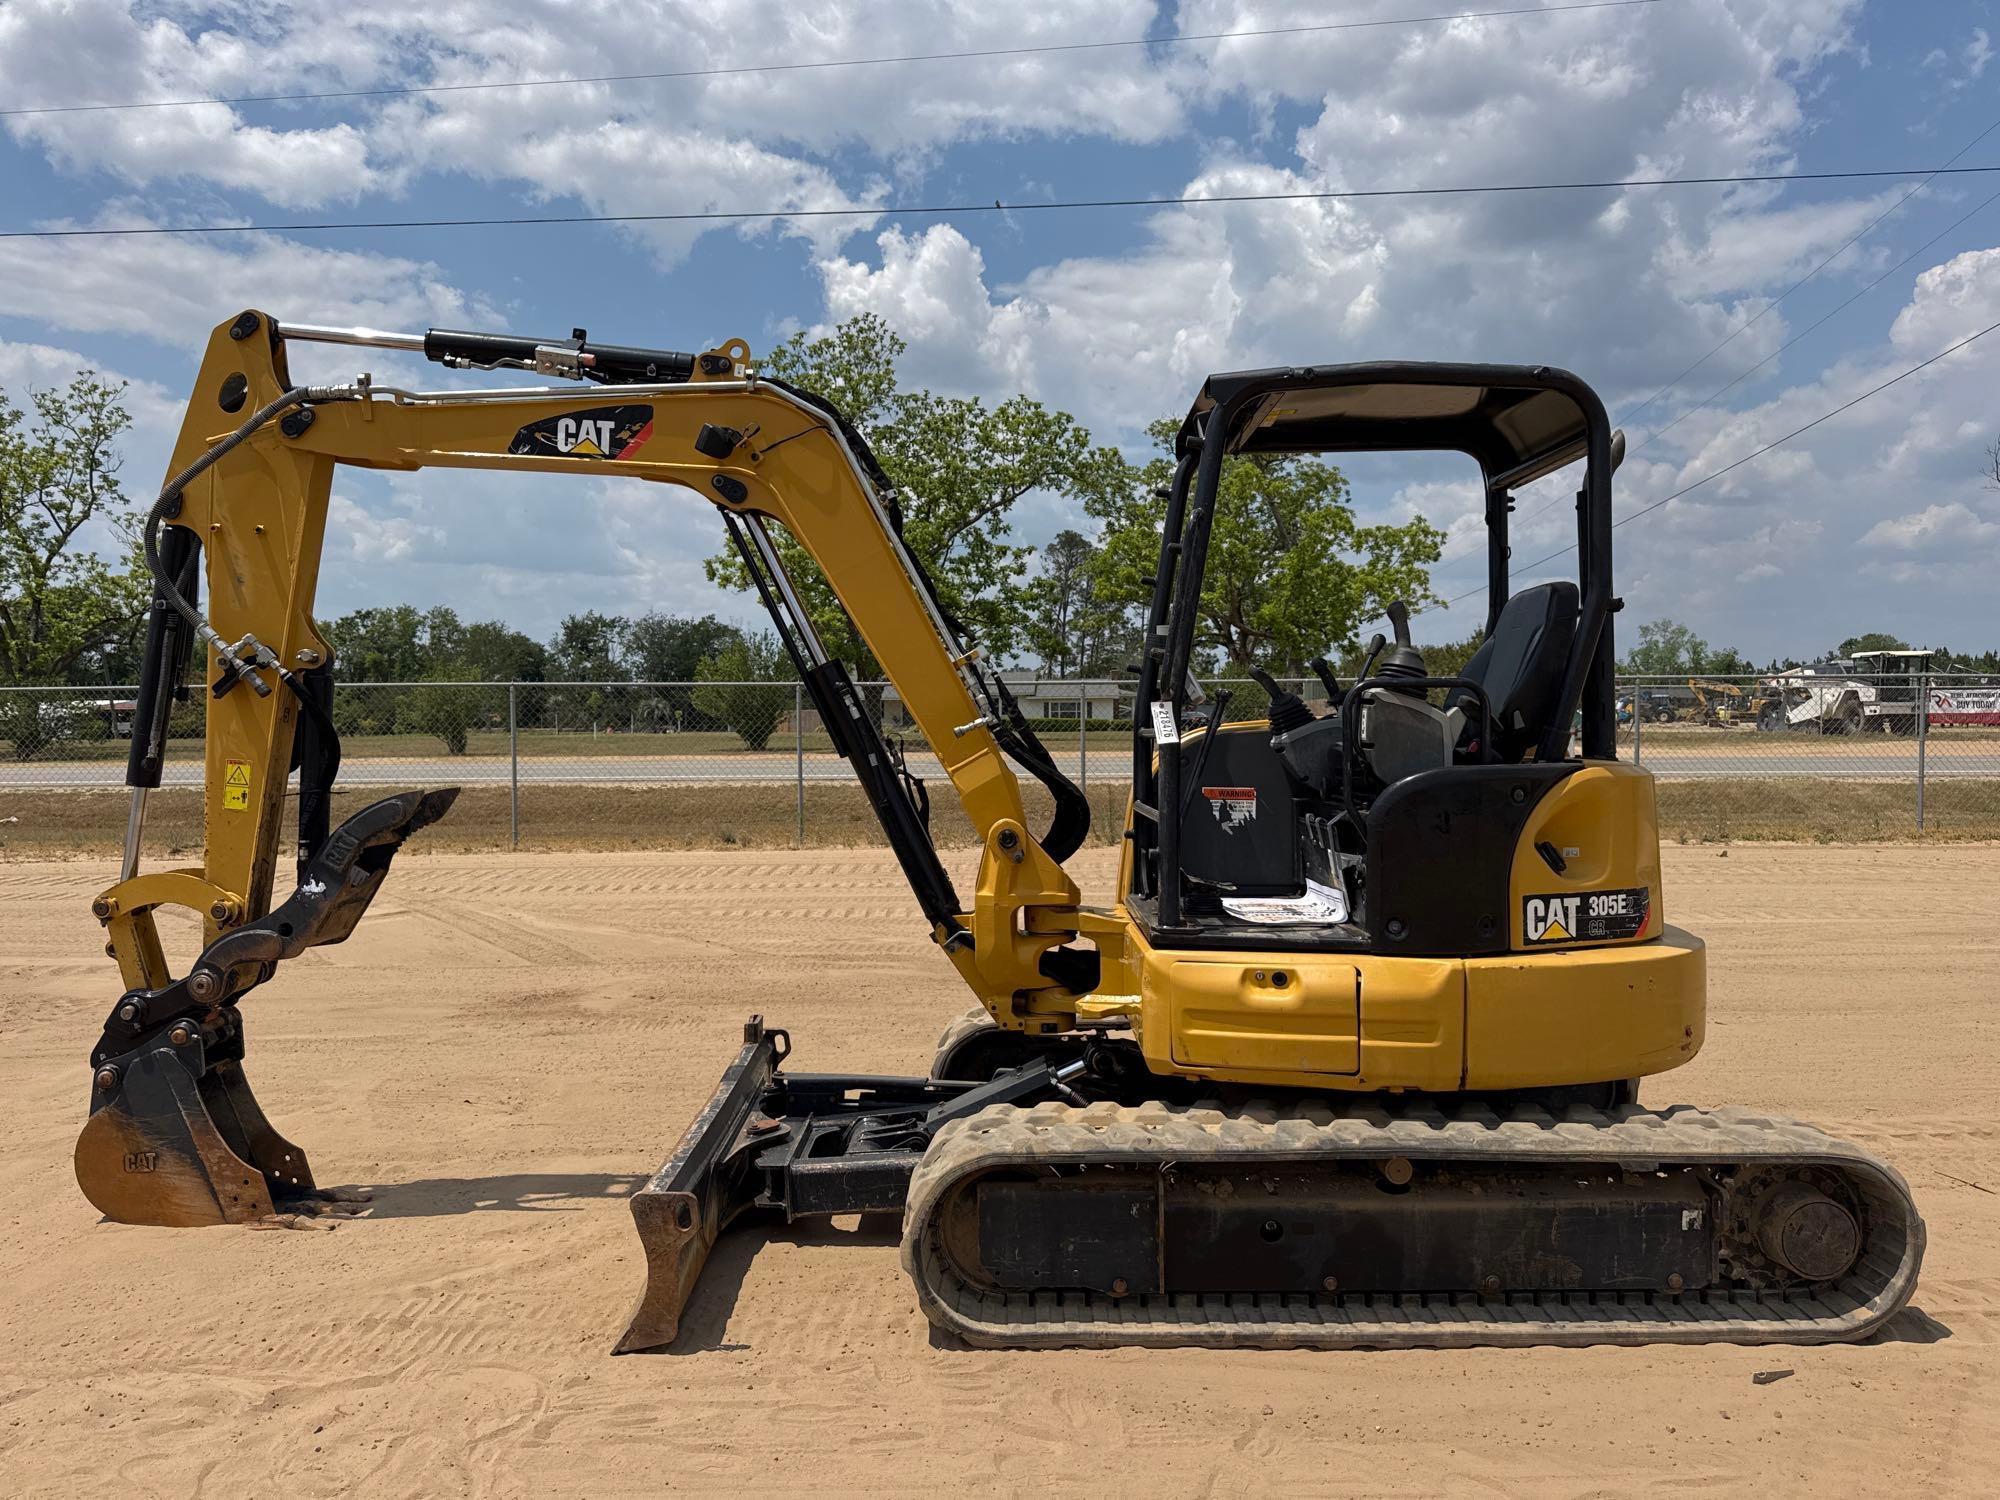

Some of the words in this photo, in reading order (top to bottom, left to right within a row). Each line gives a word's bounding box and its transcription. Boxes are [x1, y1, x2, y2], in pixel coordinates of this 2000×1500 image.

[556, 417, 615, 455] CAT
[1956, 700, 1969, 709] BUY
[1158, 710, 1174, 738] 218476
[1218, 790, 1252, 798] WARNING
[1526, 896, 1581, 941] CAT
[1588, 919, 1606, 936] CR
[123, 1151, 156, 1174] CAT
